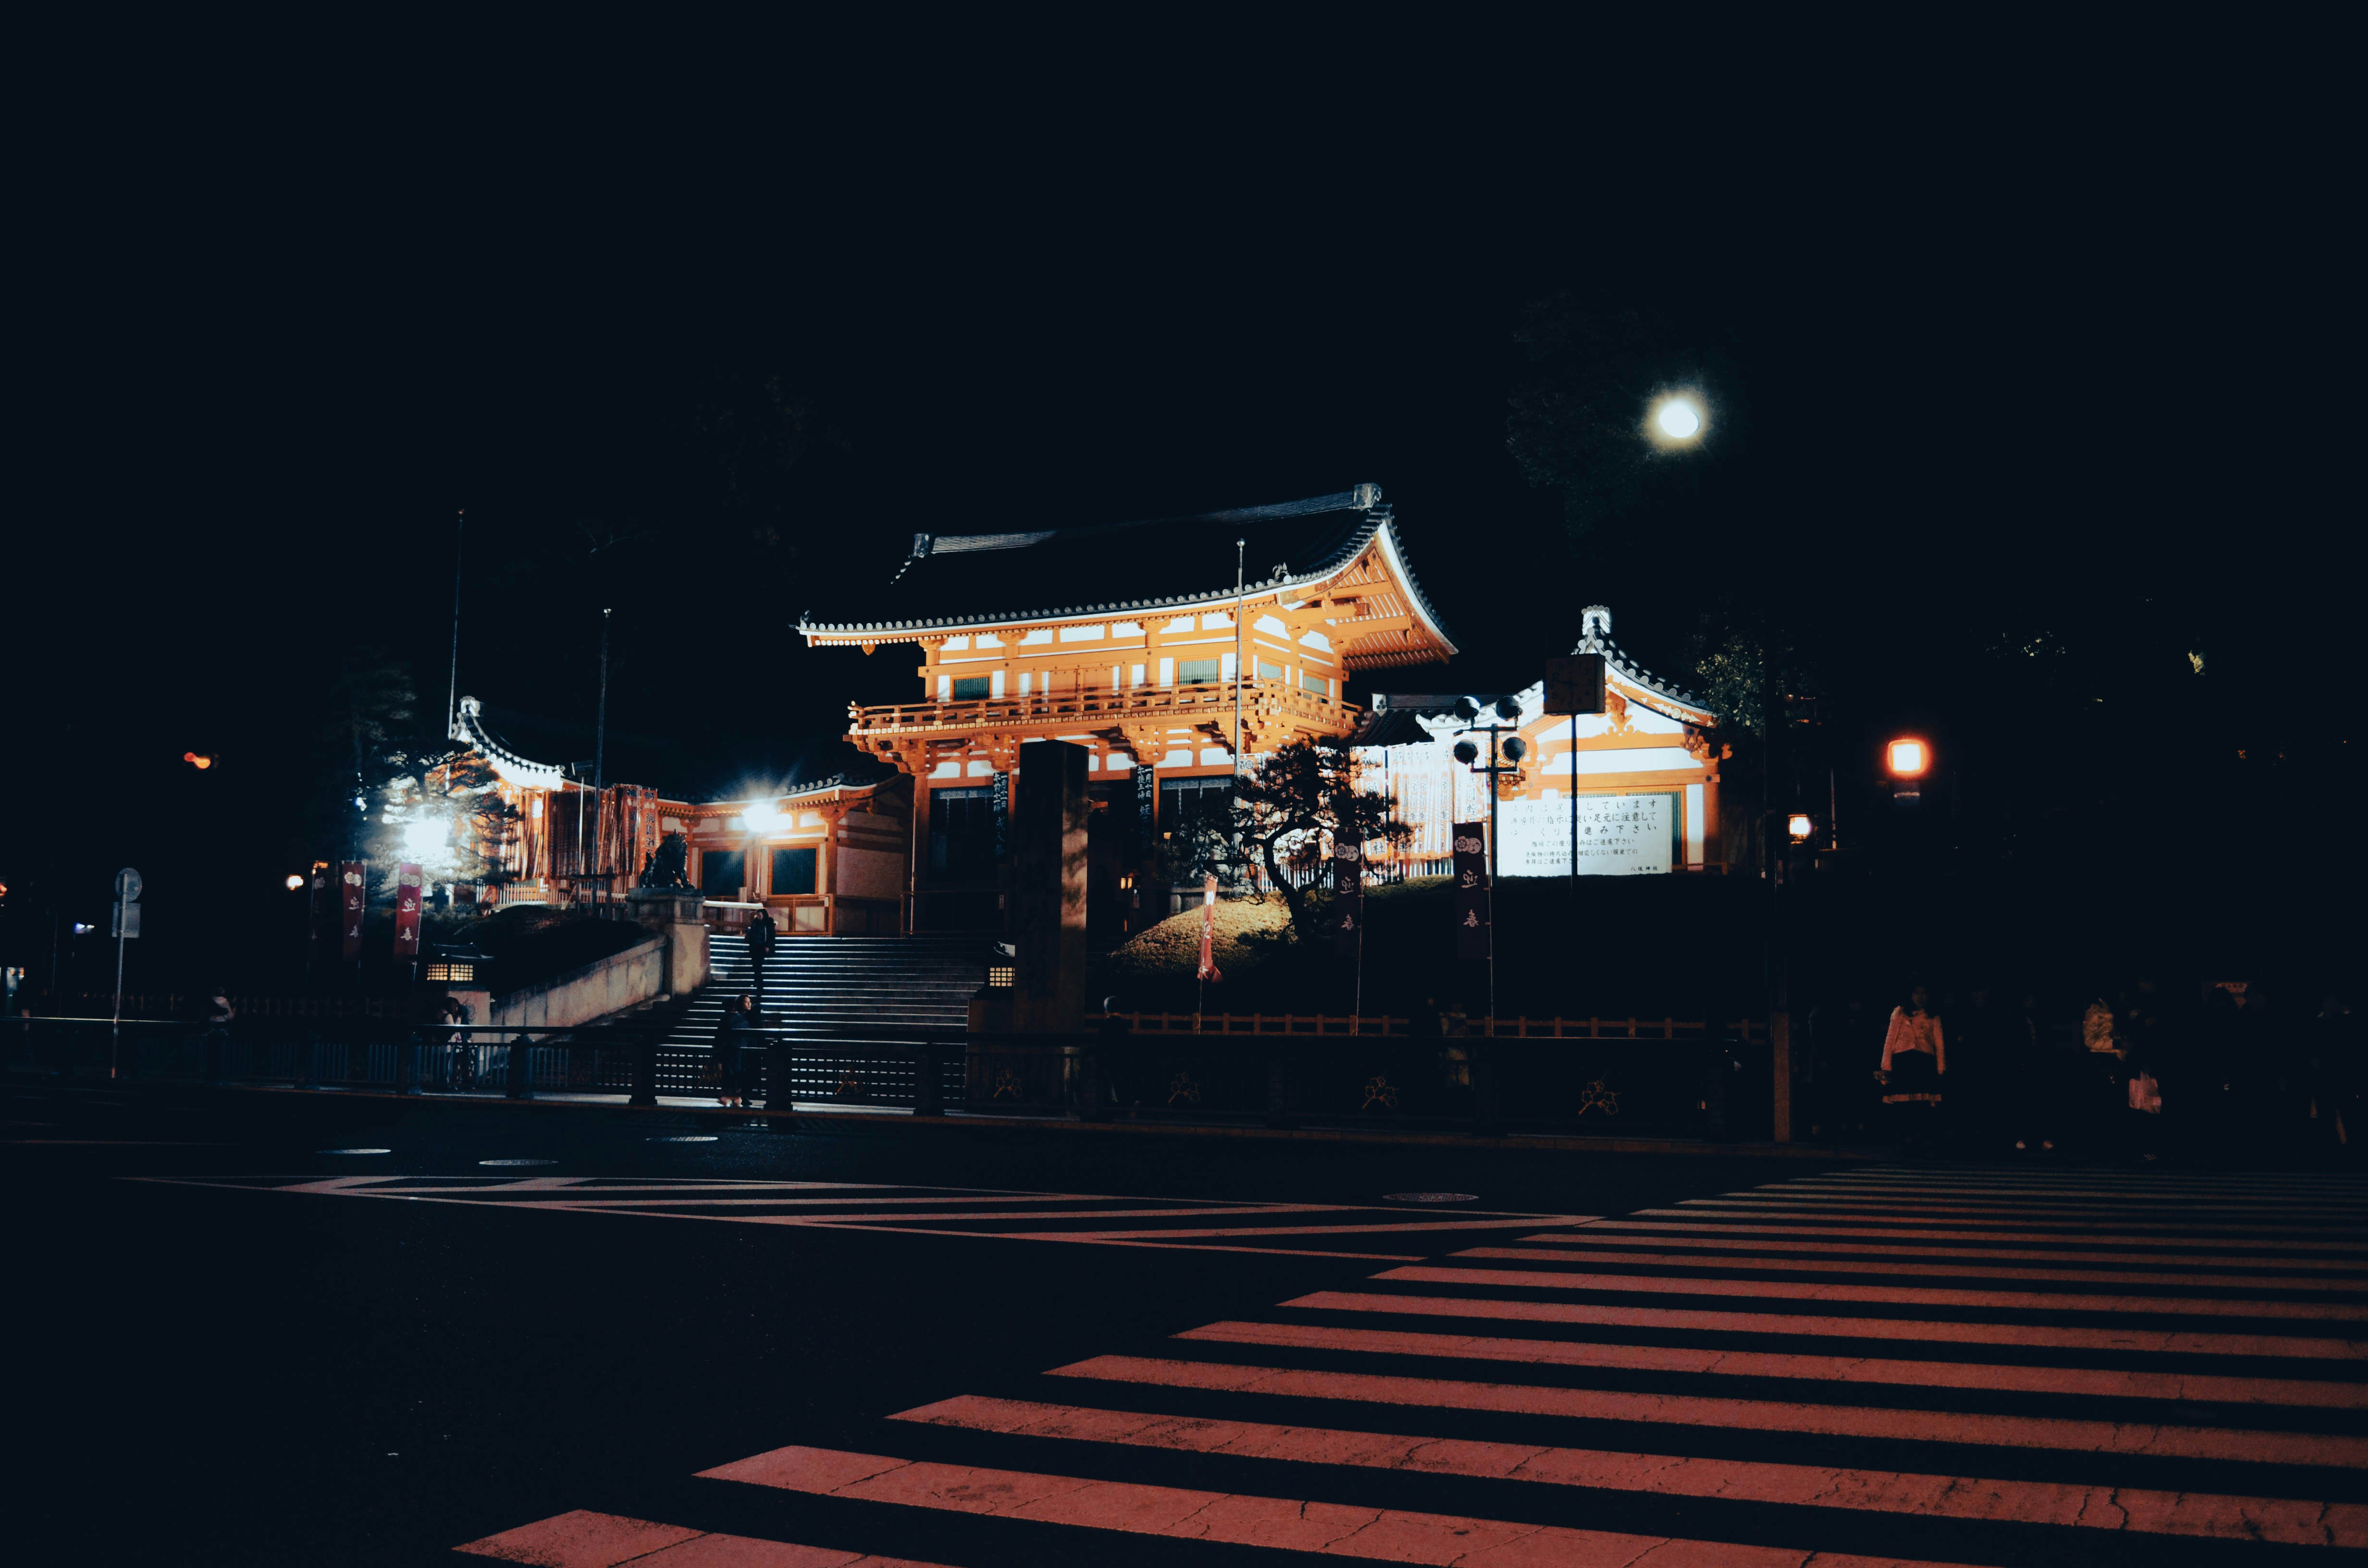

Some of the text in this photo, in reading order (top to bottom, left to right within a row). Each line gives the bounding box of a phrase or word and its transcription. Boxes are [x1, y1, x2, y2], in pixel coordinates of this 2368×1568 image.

[993, 772, 1001, 812] 午前十一時
[1000, 775, 1008, 808] 一月十一日
[1137, 766, 1146, 800] 午後三時
[1145, 768, 1153, 798] 一月十日
[1531, 838, 1634, 847] 階段での座りみはご遠慮下さい
